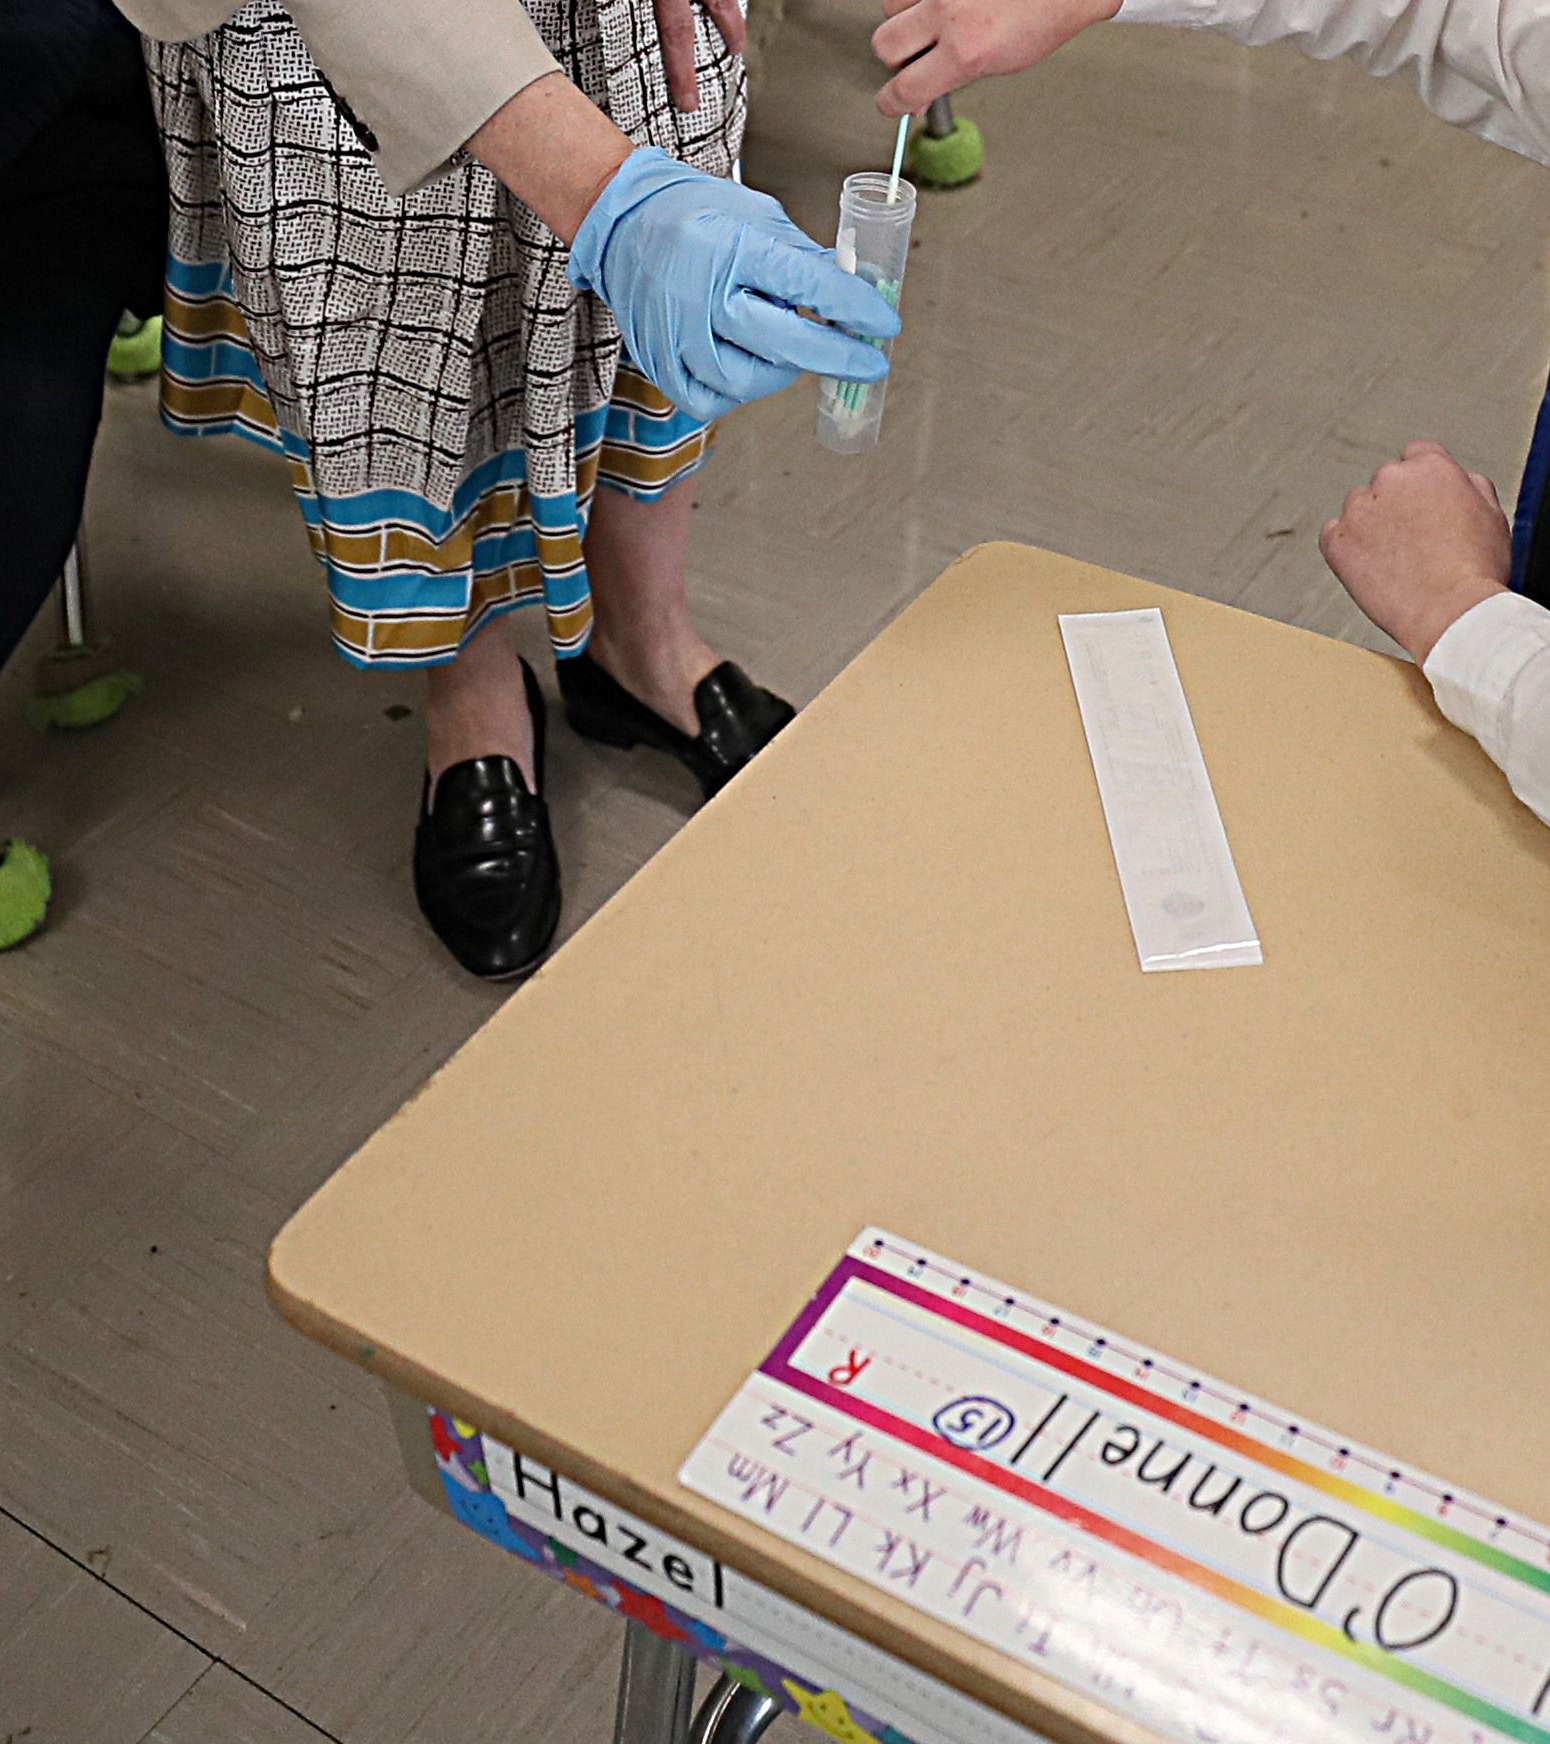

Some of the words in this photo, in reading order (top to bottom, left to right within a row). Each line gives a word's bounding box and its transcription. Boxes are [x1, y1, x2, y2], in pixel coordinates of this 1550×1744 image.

[820, 1350, 870, 1394] R
[762, 1405, 815, 1455] Zz
[951, 1402, 1004, 1440] 15
[728, 1453, 789, 1512] Mm
[830, 1432, 871, 1489] Yy
[802, 1497, 855, 1546] Ll
[894, 1469, 946, 1521] Xx
[512, 1450, 729, 1609] Hazel
[966, 1505, 1021, 1561] Ww
[1010, 1392, 1459, 1654] O'Donnell
[878, 1531, 931, 1586] Kk
[948, 1557, 1004, 1609] Jj
